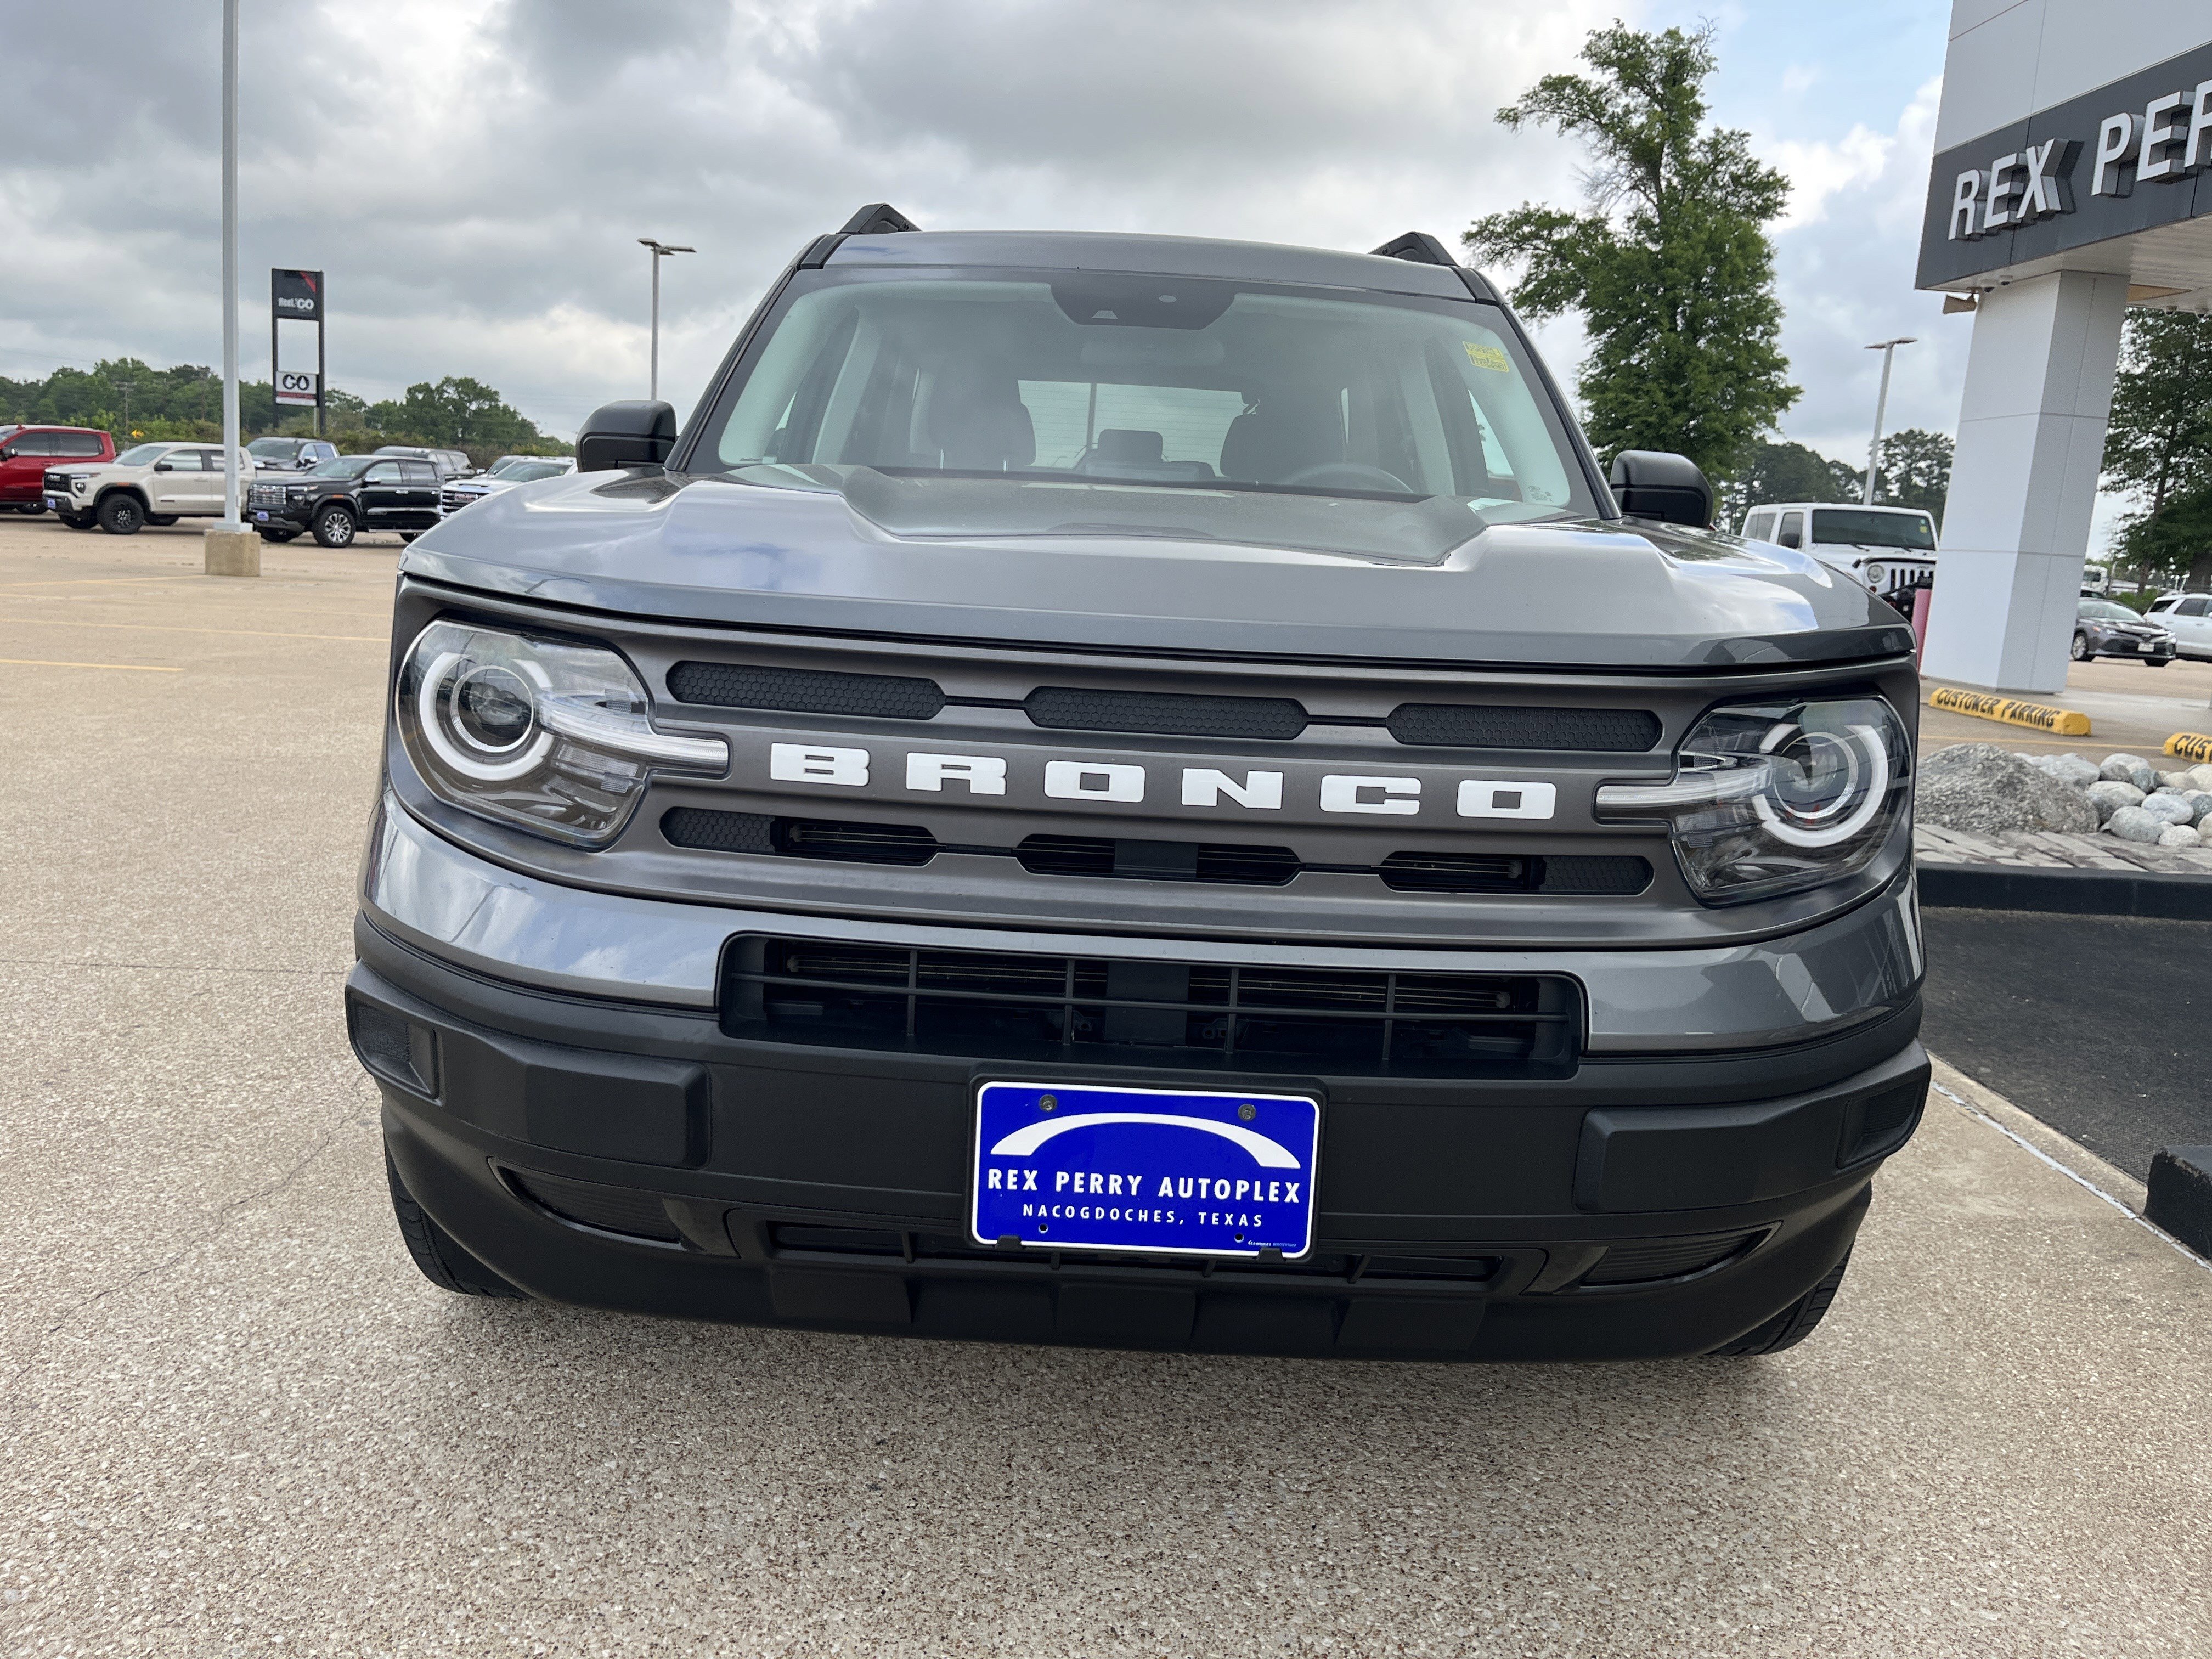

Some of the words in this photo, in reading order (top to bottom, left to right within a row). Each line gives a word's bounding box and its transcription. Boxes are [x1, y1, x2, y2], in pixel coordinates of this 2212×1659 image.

[1948, 138, 2061, 240] REX
[1937, 689, 2001, 715] CUSTOMER
[2001, 701, 2061, 728] PARKING
[770, 742, 1557, 820] BRONCO
[988, 1167, 1039, 1192] REX
[1055, 1170, 1143, 1196] PERRY
[1157, 1176, 1300, 1204] AUTOPLEX
[1022, 1203, 1184, 1226] NACOGDOCHES,
[1198, 1211, 1262, 1227] TEXAS
